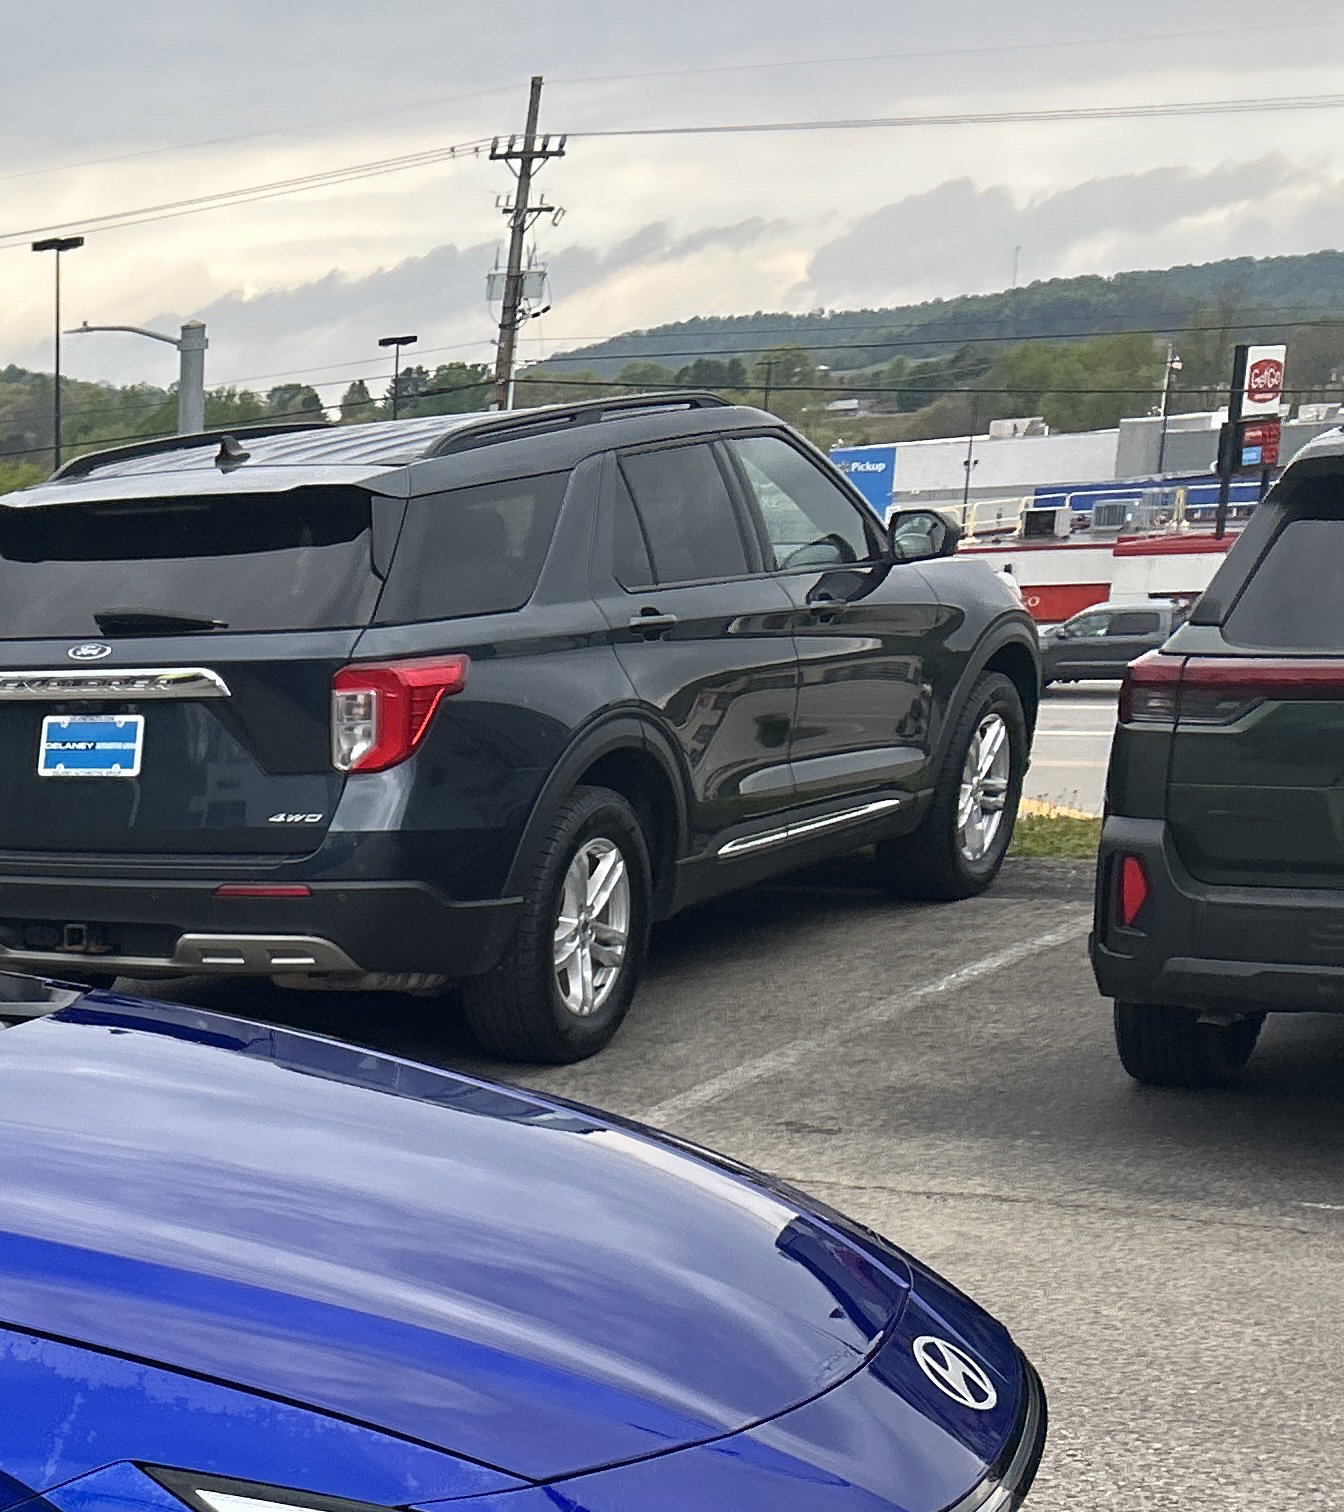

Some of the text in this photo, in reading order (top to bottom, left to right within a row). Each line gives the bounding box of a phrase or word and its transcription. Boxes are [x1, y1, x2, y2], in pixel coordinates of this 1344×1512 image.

[851, 461, 886, 473] Pickup
[45, 742, 95, 750] DELANEY
[268, 813, 323, 822] 4WD
